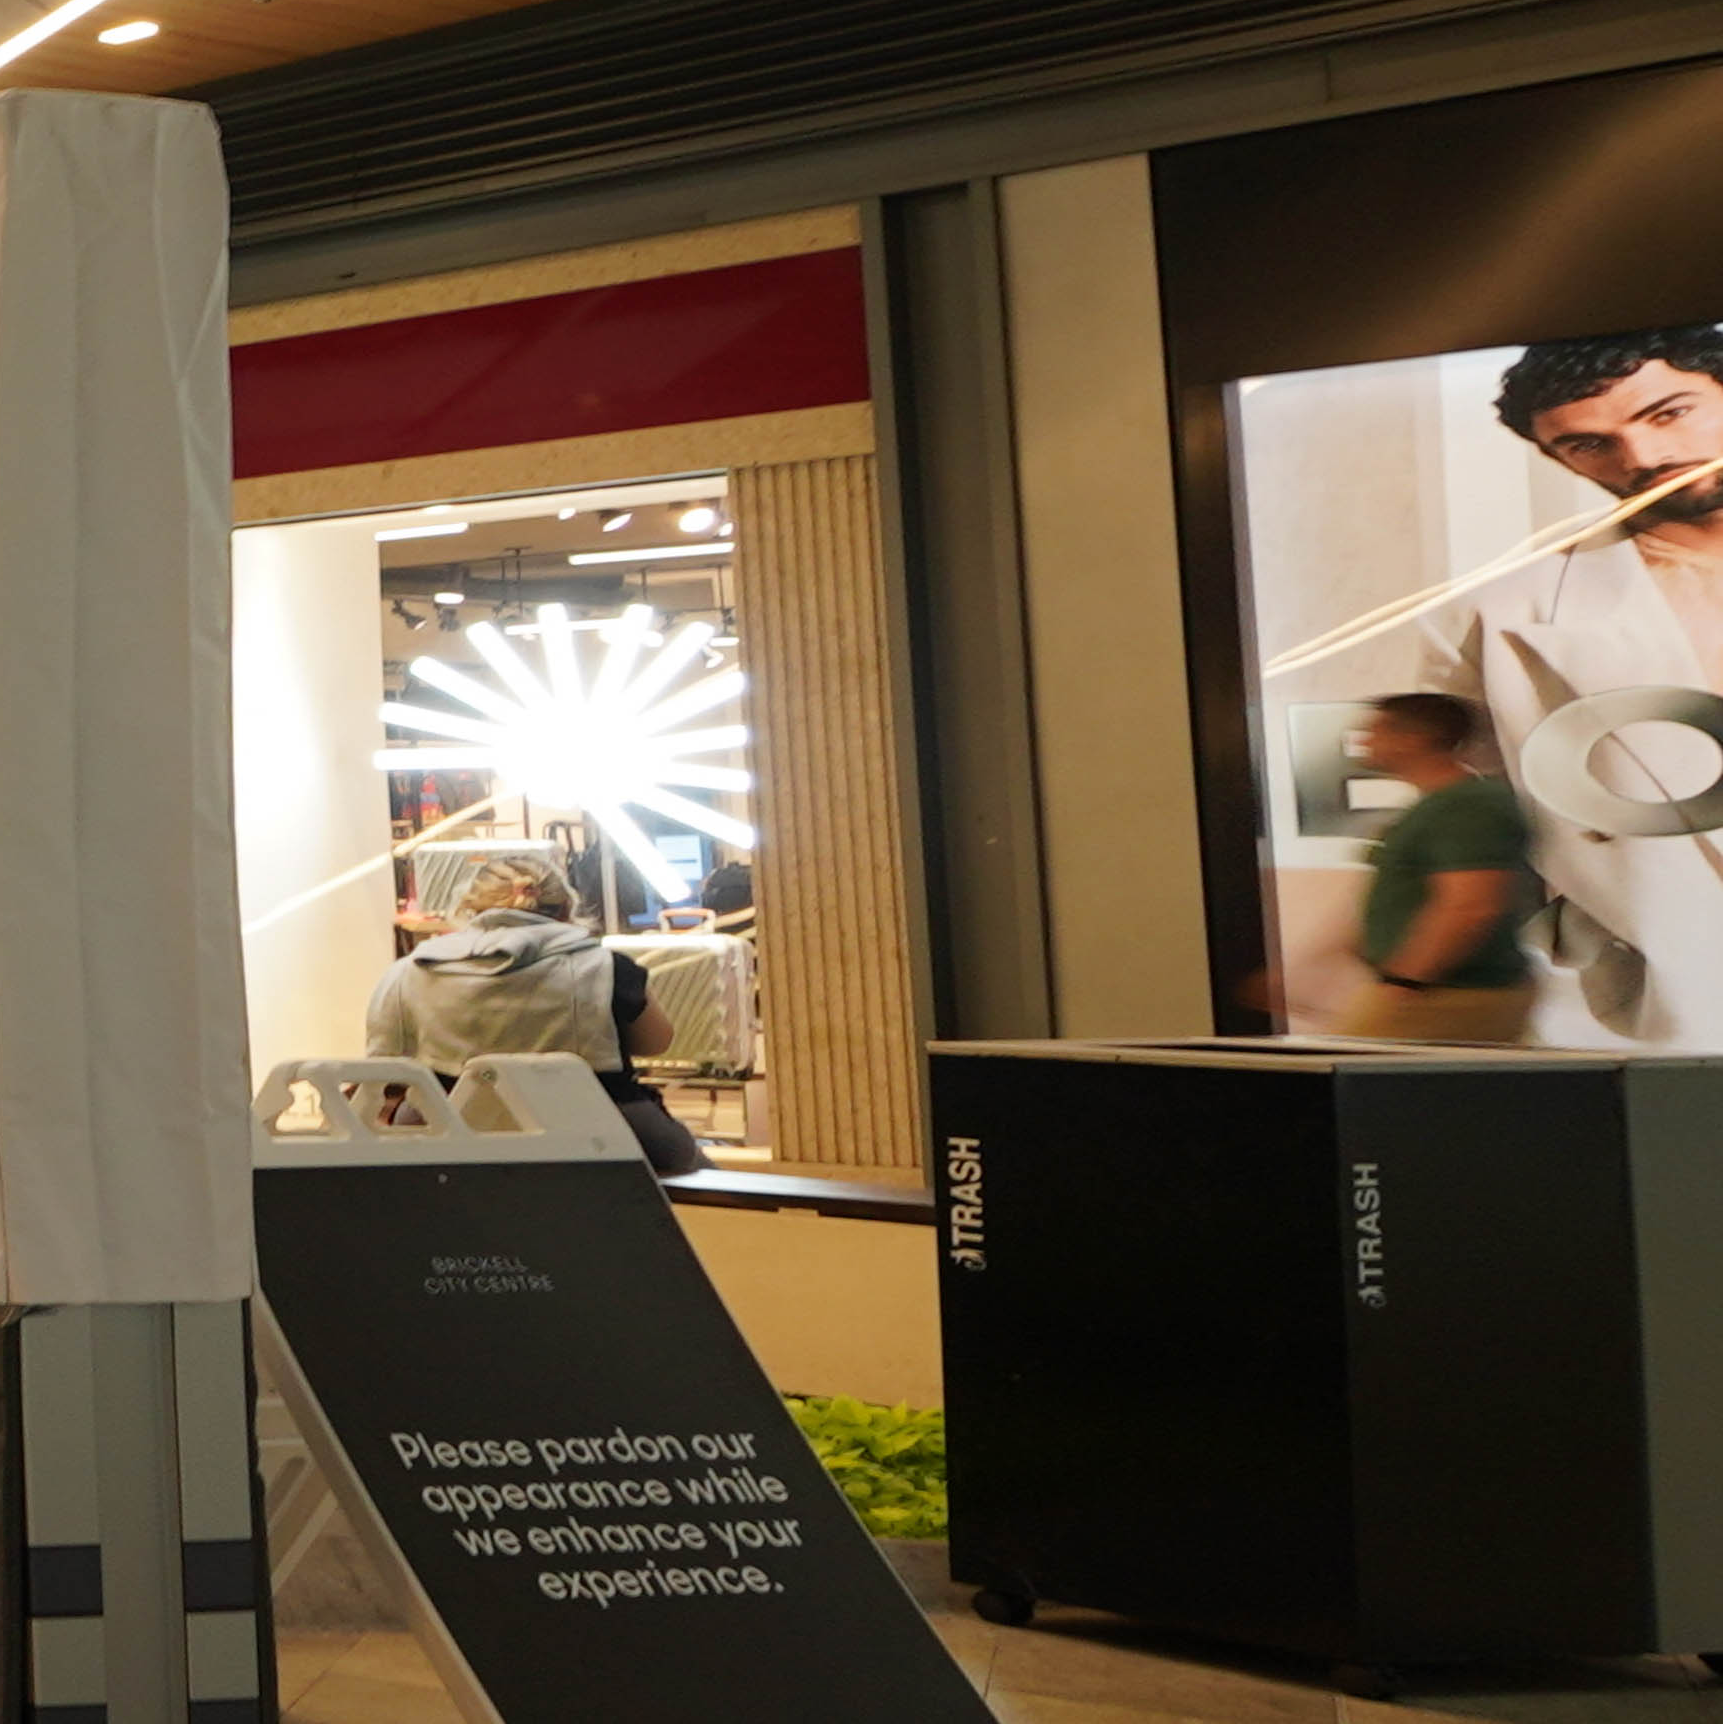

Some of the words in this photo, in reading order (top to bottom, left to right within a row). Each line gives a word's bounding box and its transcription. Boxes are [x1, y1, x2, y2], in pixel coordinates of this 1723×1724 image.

[947, 1136, 986, 1247] TRASH
[1352, 1163, 1384, 1285] TRASH
[390, 1432, 533, 1470] Please
[536, 1425, 688, 1474] pardon
[691, 1432, 757, 1462] our
[421, 1481, 673, 1523] appearance
[674, 1467, 789, 1506] while
[454, 1526, 523, 1557] we
[527, 1516, 708, 1556] enhance
[708, 1517, 803, 1559] your
[537, 1559, 786, 1610] experience.
